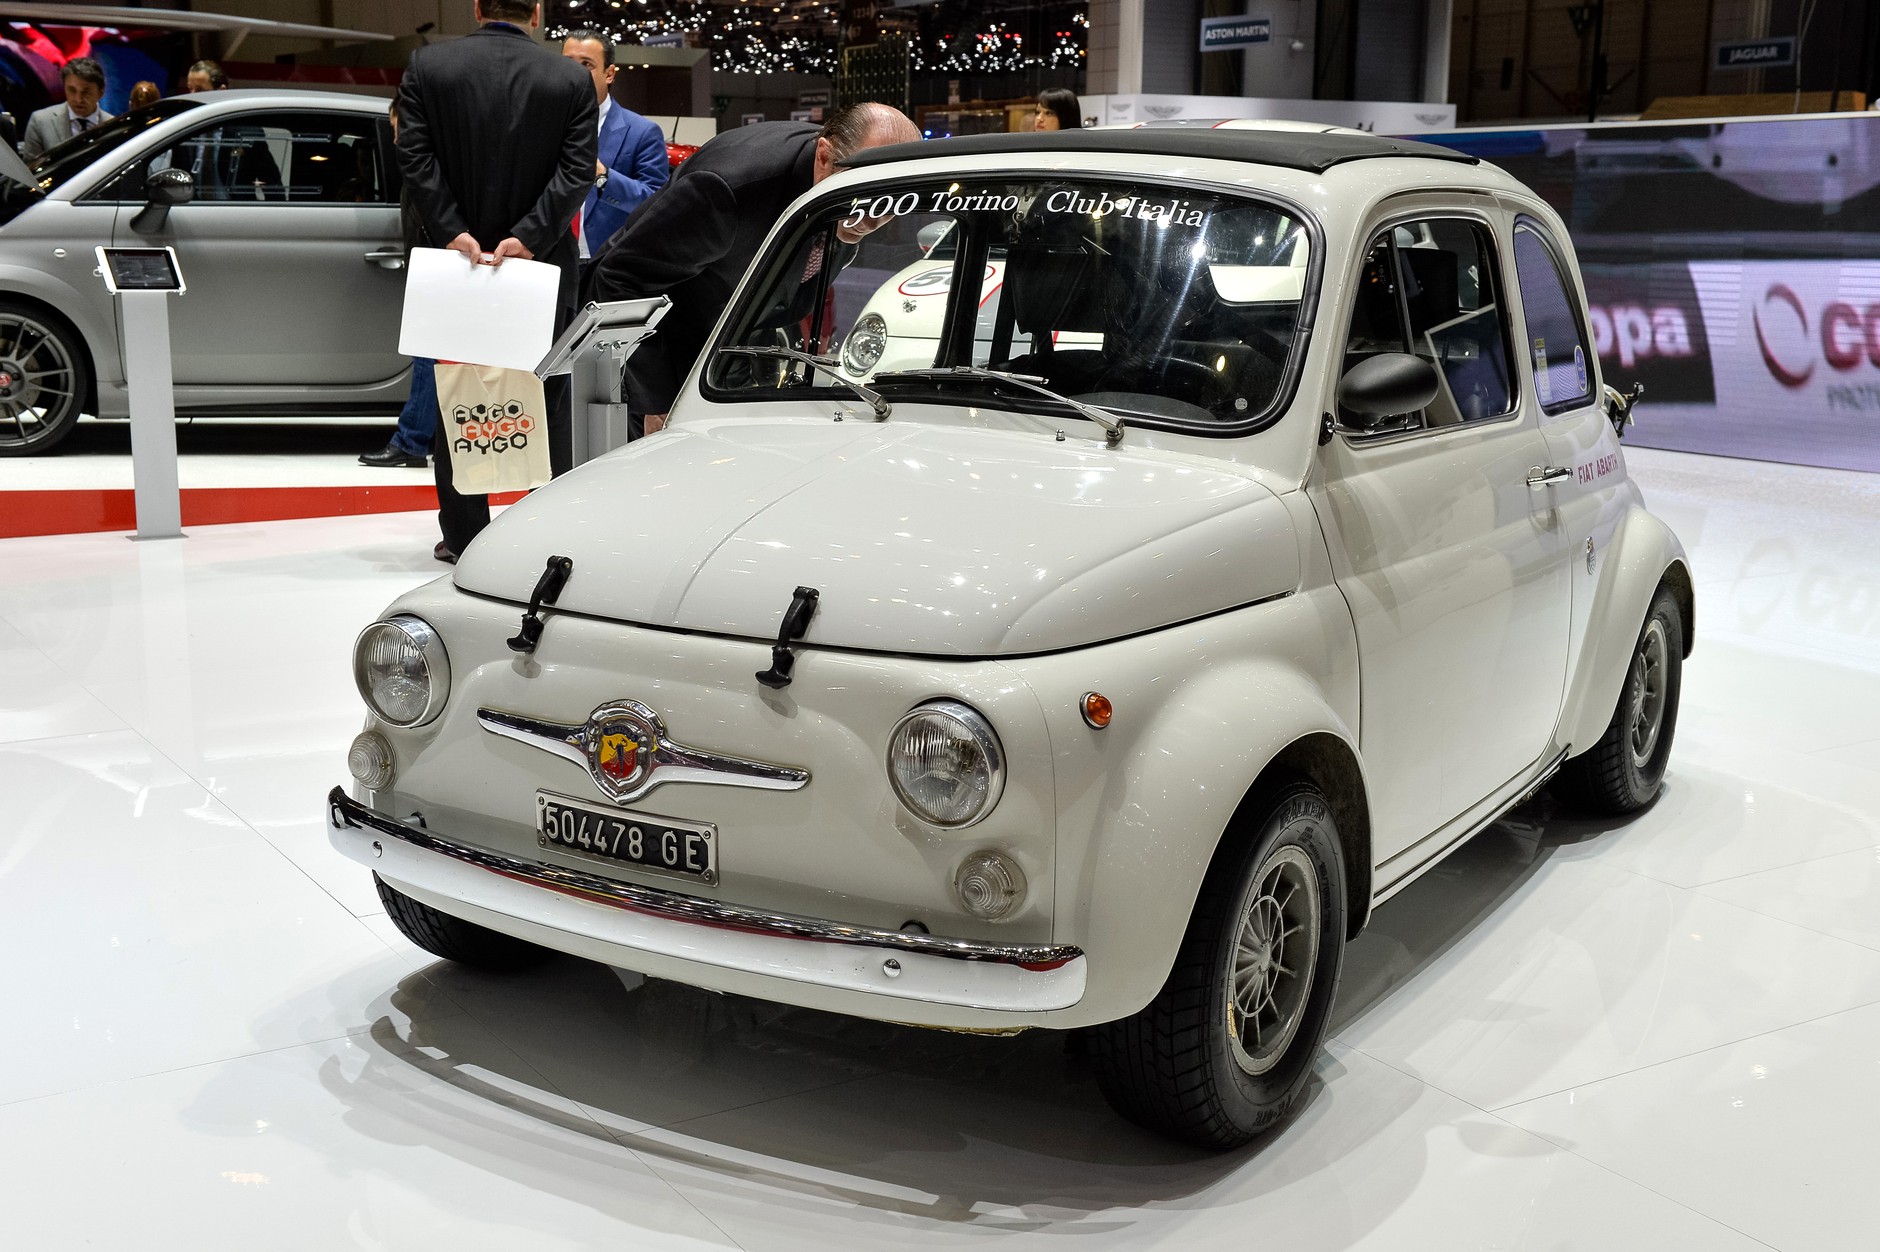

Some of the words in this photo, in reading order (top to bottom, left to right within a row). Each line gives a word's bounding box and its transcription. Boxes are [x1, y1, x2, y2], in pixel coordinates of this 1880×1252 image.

[1206, 28, 1234, 40] ASTON
[1236, 25, 1269, 37] MARTIN
[1729, 46, 1778, 63] JAGUAR
[842, 193, 920, 228] 500
[929, 189, 1019, 212] Torino
[1046, 190, 1116, 216] Club
[1121, 196, 1204, 228] Italia
[453, 399, 524, 425] AYGO
[461, 414, 536, 441] AYGO
[454, 432, 528, 455] AYGO
[1577, 462, 1594, 485] FIAT
[1596, 453, 1619, 477] ABARTH
[1280, 800, 1326, 831] FALKEN
[545, 805, 643, 860] 504478
[661, 830, 703, 871] GE
